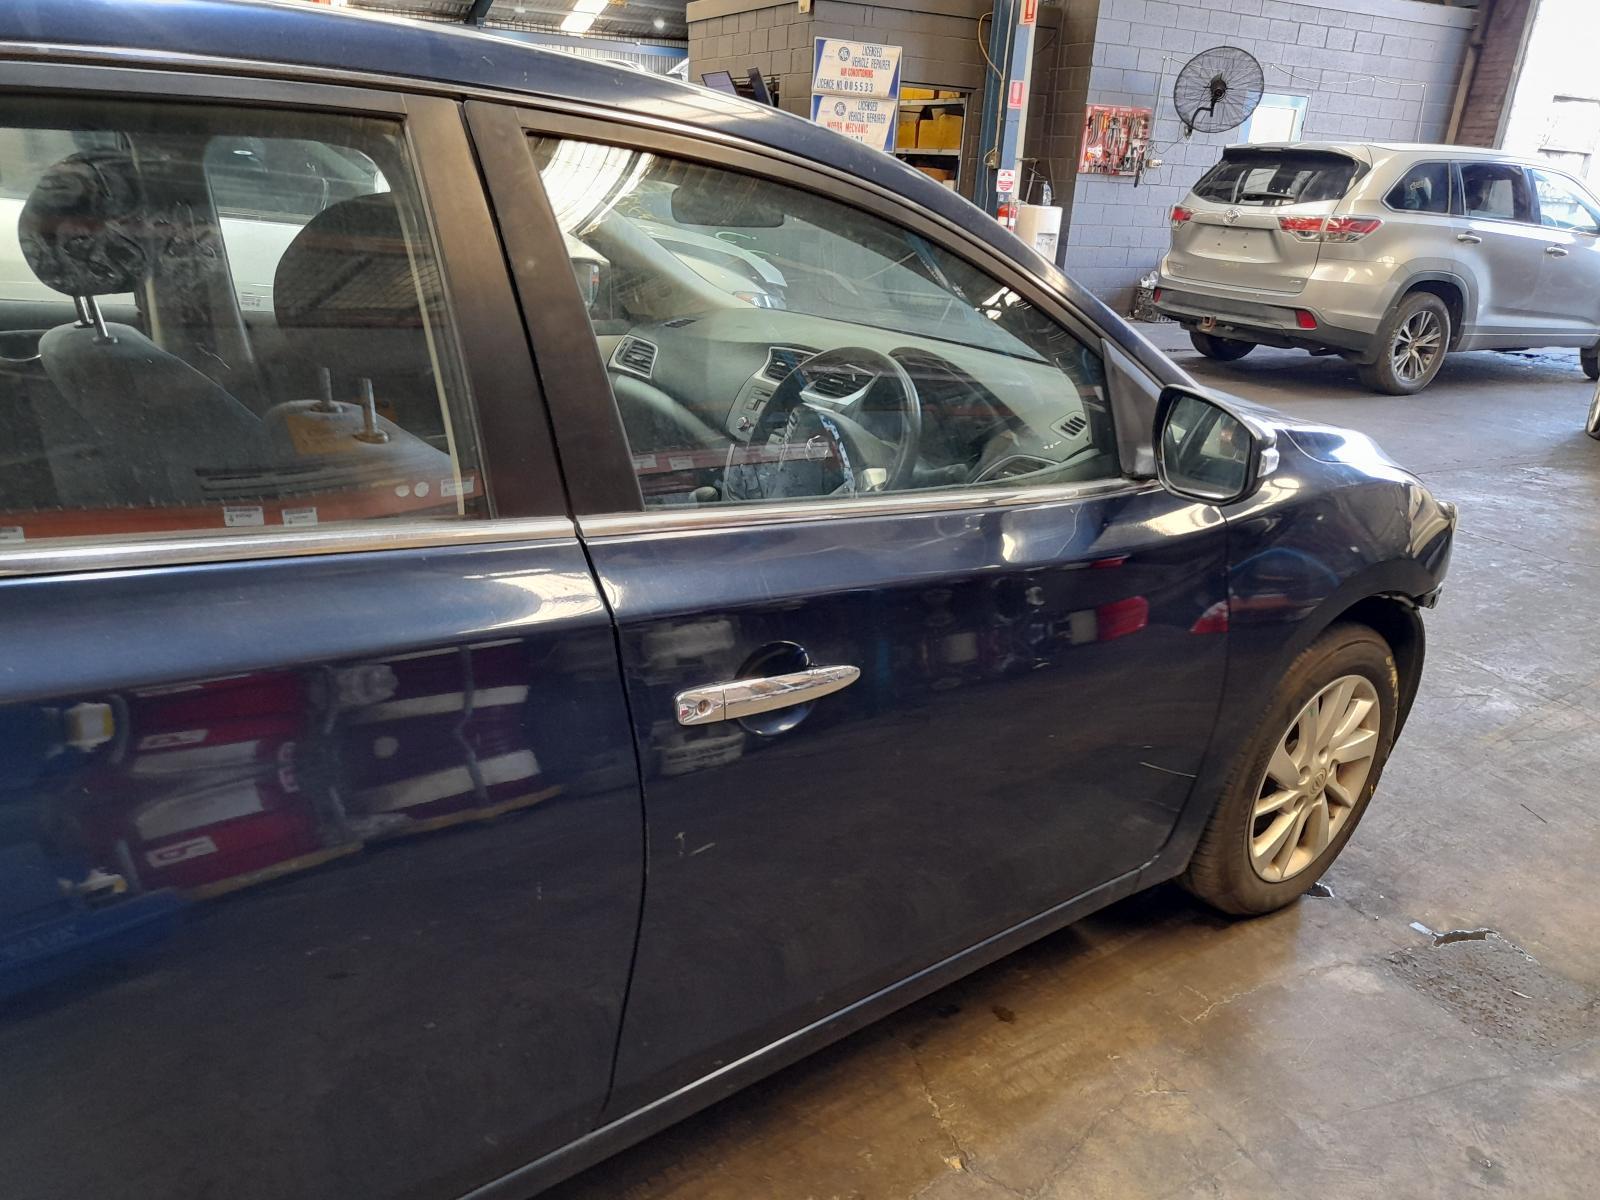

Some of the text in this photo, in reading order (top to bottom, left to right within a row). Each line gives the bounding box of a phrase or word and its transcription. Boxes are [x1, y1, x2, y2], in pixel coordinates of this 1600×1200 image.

[851, 57, 890, 70] VEHICLE REPAIRER
[848, 111, 886, 124] VEHICLE REPAIRER
[845, 122, 869, 134] MECHANIC
